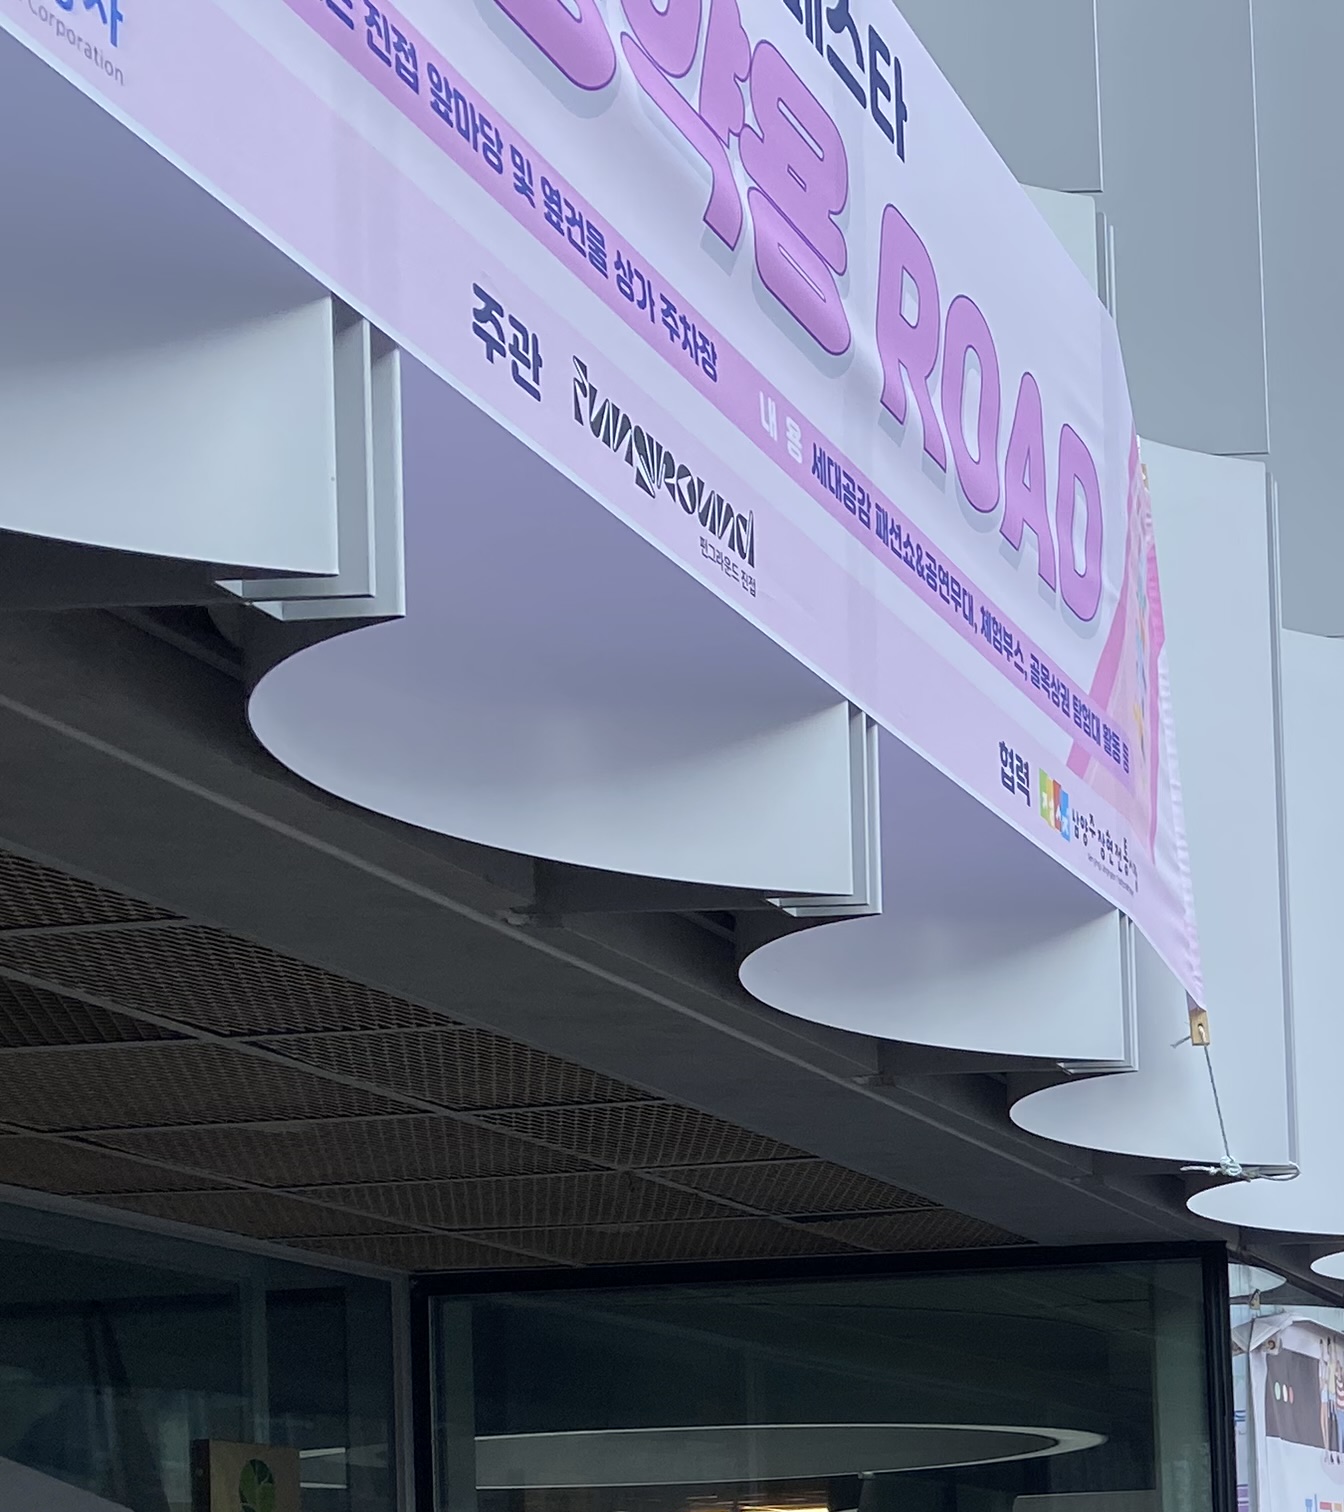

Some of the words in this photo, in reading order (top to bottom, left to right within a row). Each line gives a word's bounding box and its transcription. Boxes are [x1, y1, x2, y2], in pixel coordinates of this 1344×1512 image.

[28, 1, 125, 86] Corporation
[426, 62, 504, 175] 앞마당
[510, 143, 537, 210] 및
[540, 174, 609, 281] 옆건물
[613, 249, 656, 325] 상가
[660, 292, 719, 383] 주차장
[811, 441, 871, 531] 세대공감
[471, 282, 543, 403] 주관
[876, 203, 1103, 622] ROAD
[998, 740, 1031, 807] 협력
